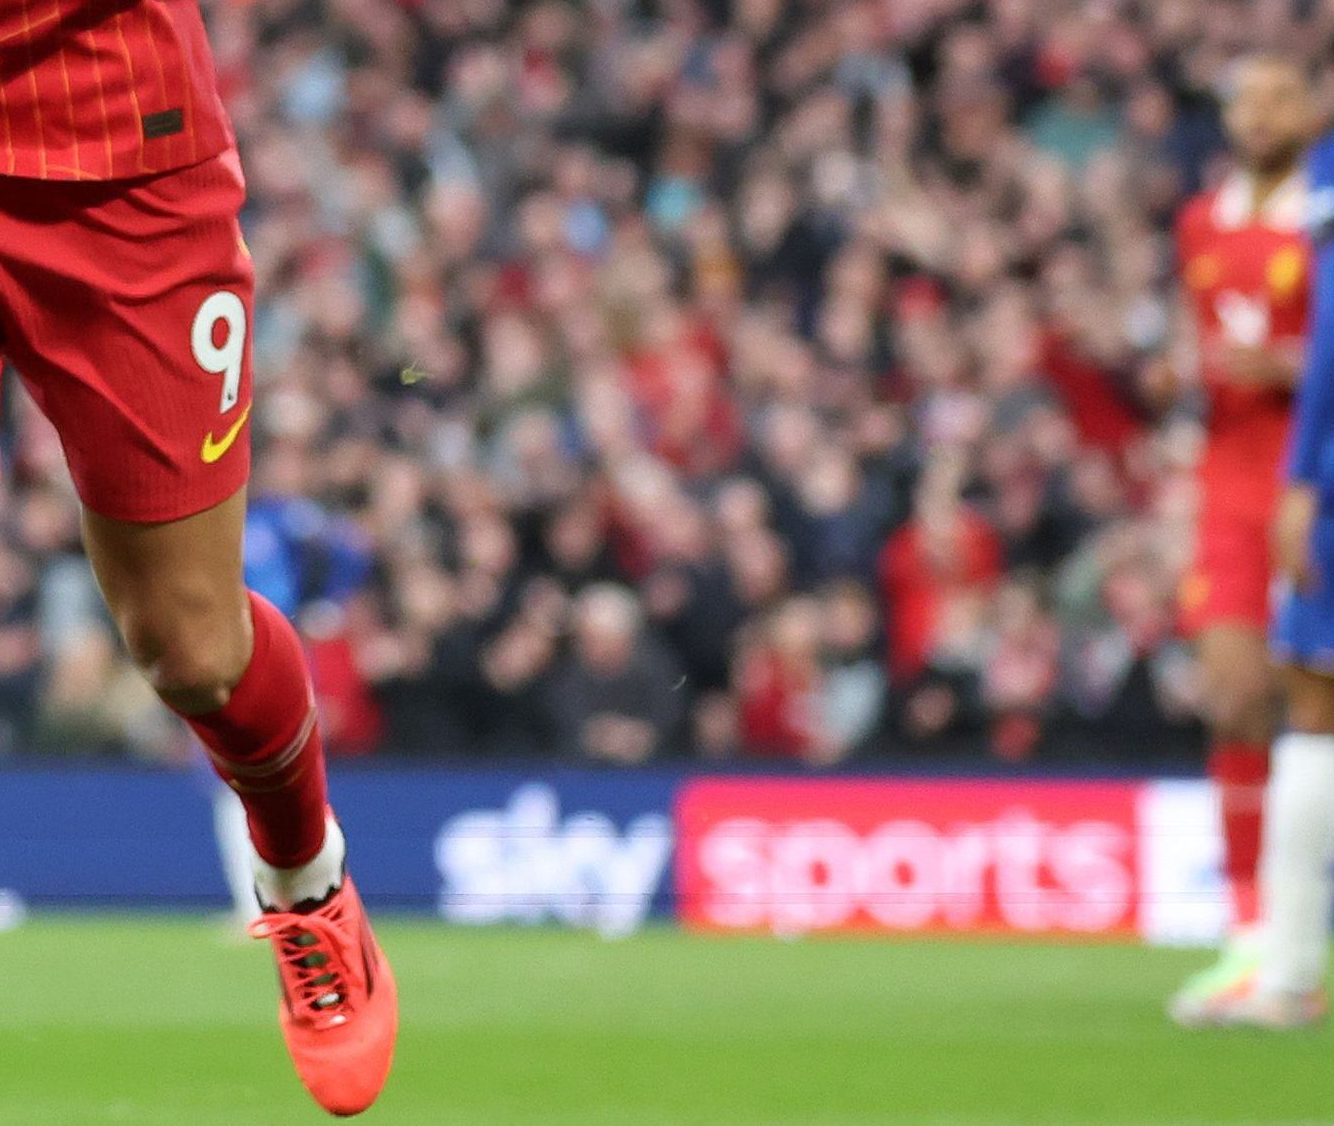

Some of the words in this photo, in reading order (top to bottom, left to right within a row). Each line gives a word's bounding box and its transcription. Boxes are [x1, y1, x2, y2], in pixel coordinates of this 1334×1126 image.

[191, 290, 247, 414] 9
[433, 784, 674, 939] sky
[698, 806, 1134, 939] sports
